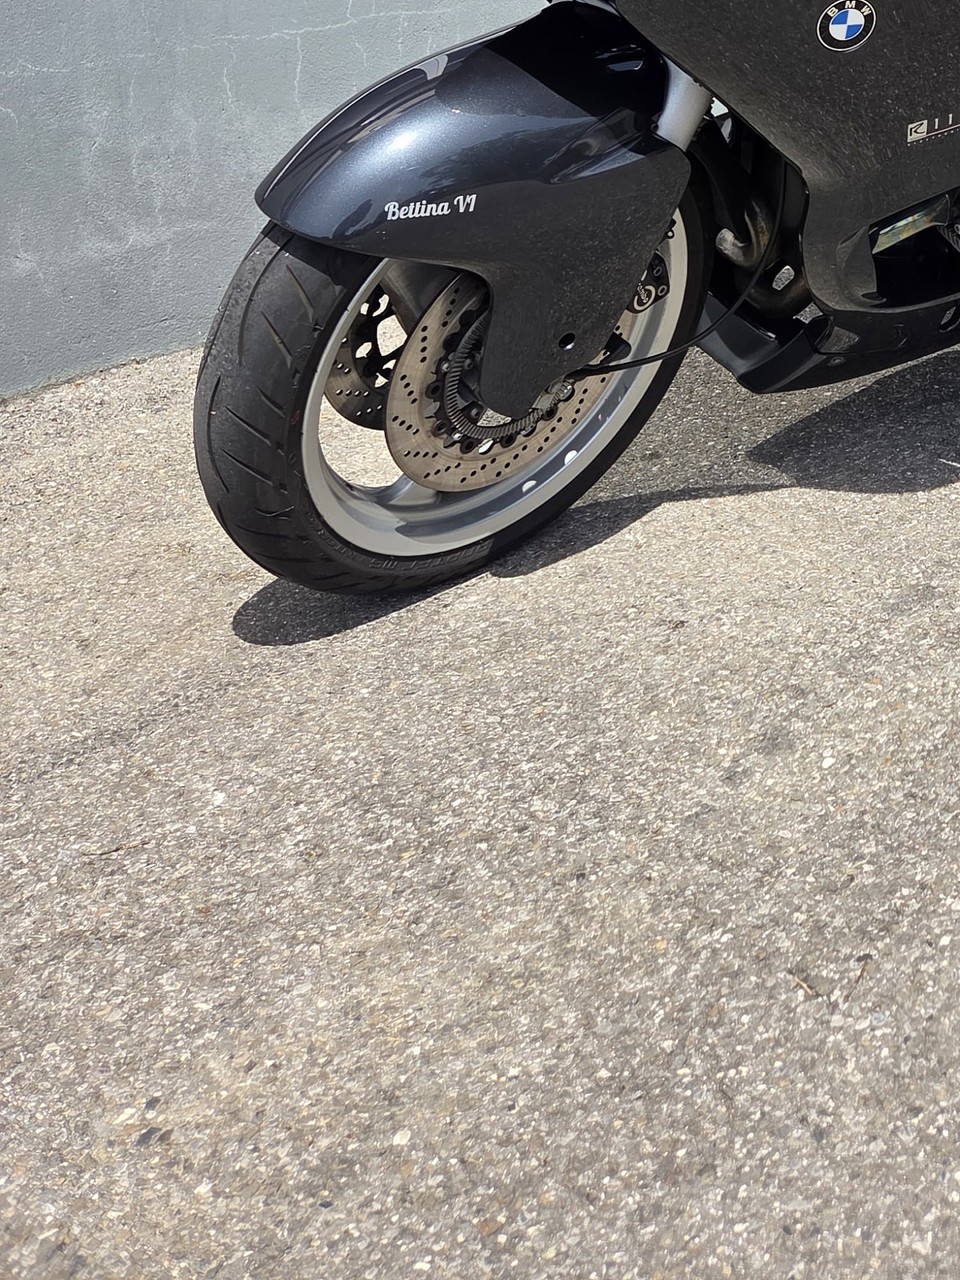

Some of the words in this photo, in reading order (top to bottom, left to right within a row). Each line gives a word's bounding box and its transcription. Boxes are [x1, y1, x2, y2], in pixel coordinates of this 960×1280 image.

[827, 0, 871, 17] BMW
[384, 200, 451, 220] Bettina
[454, 194, 477, 213] VI
